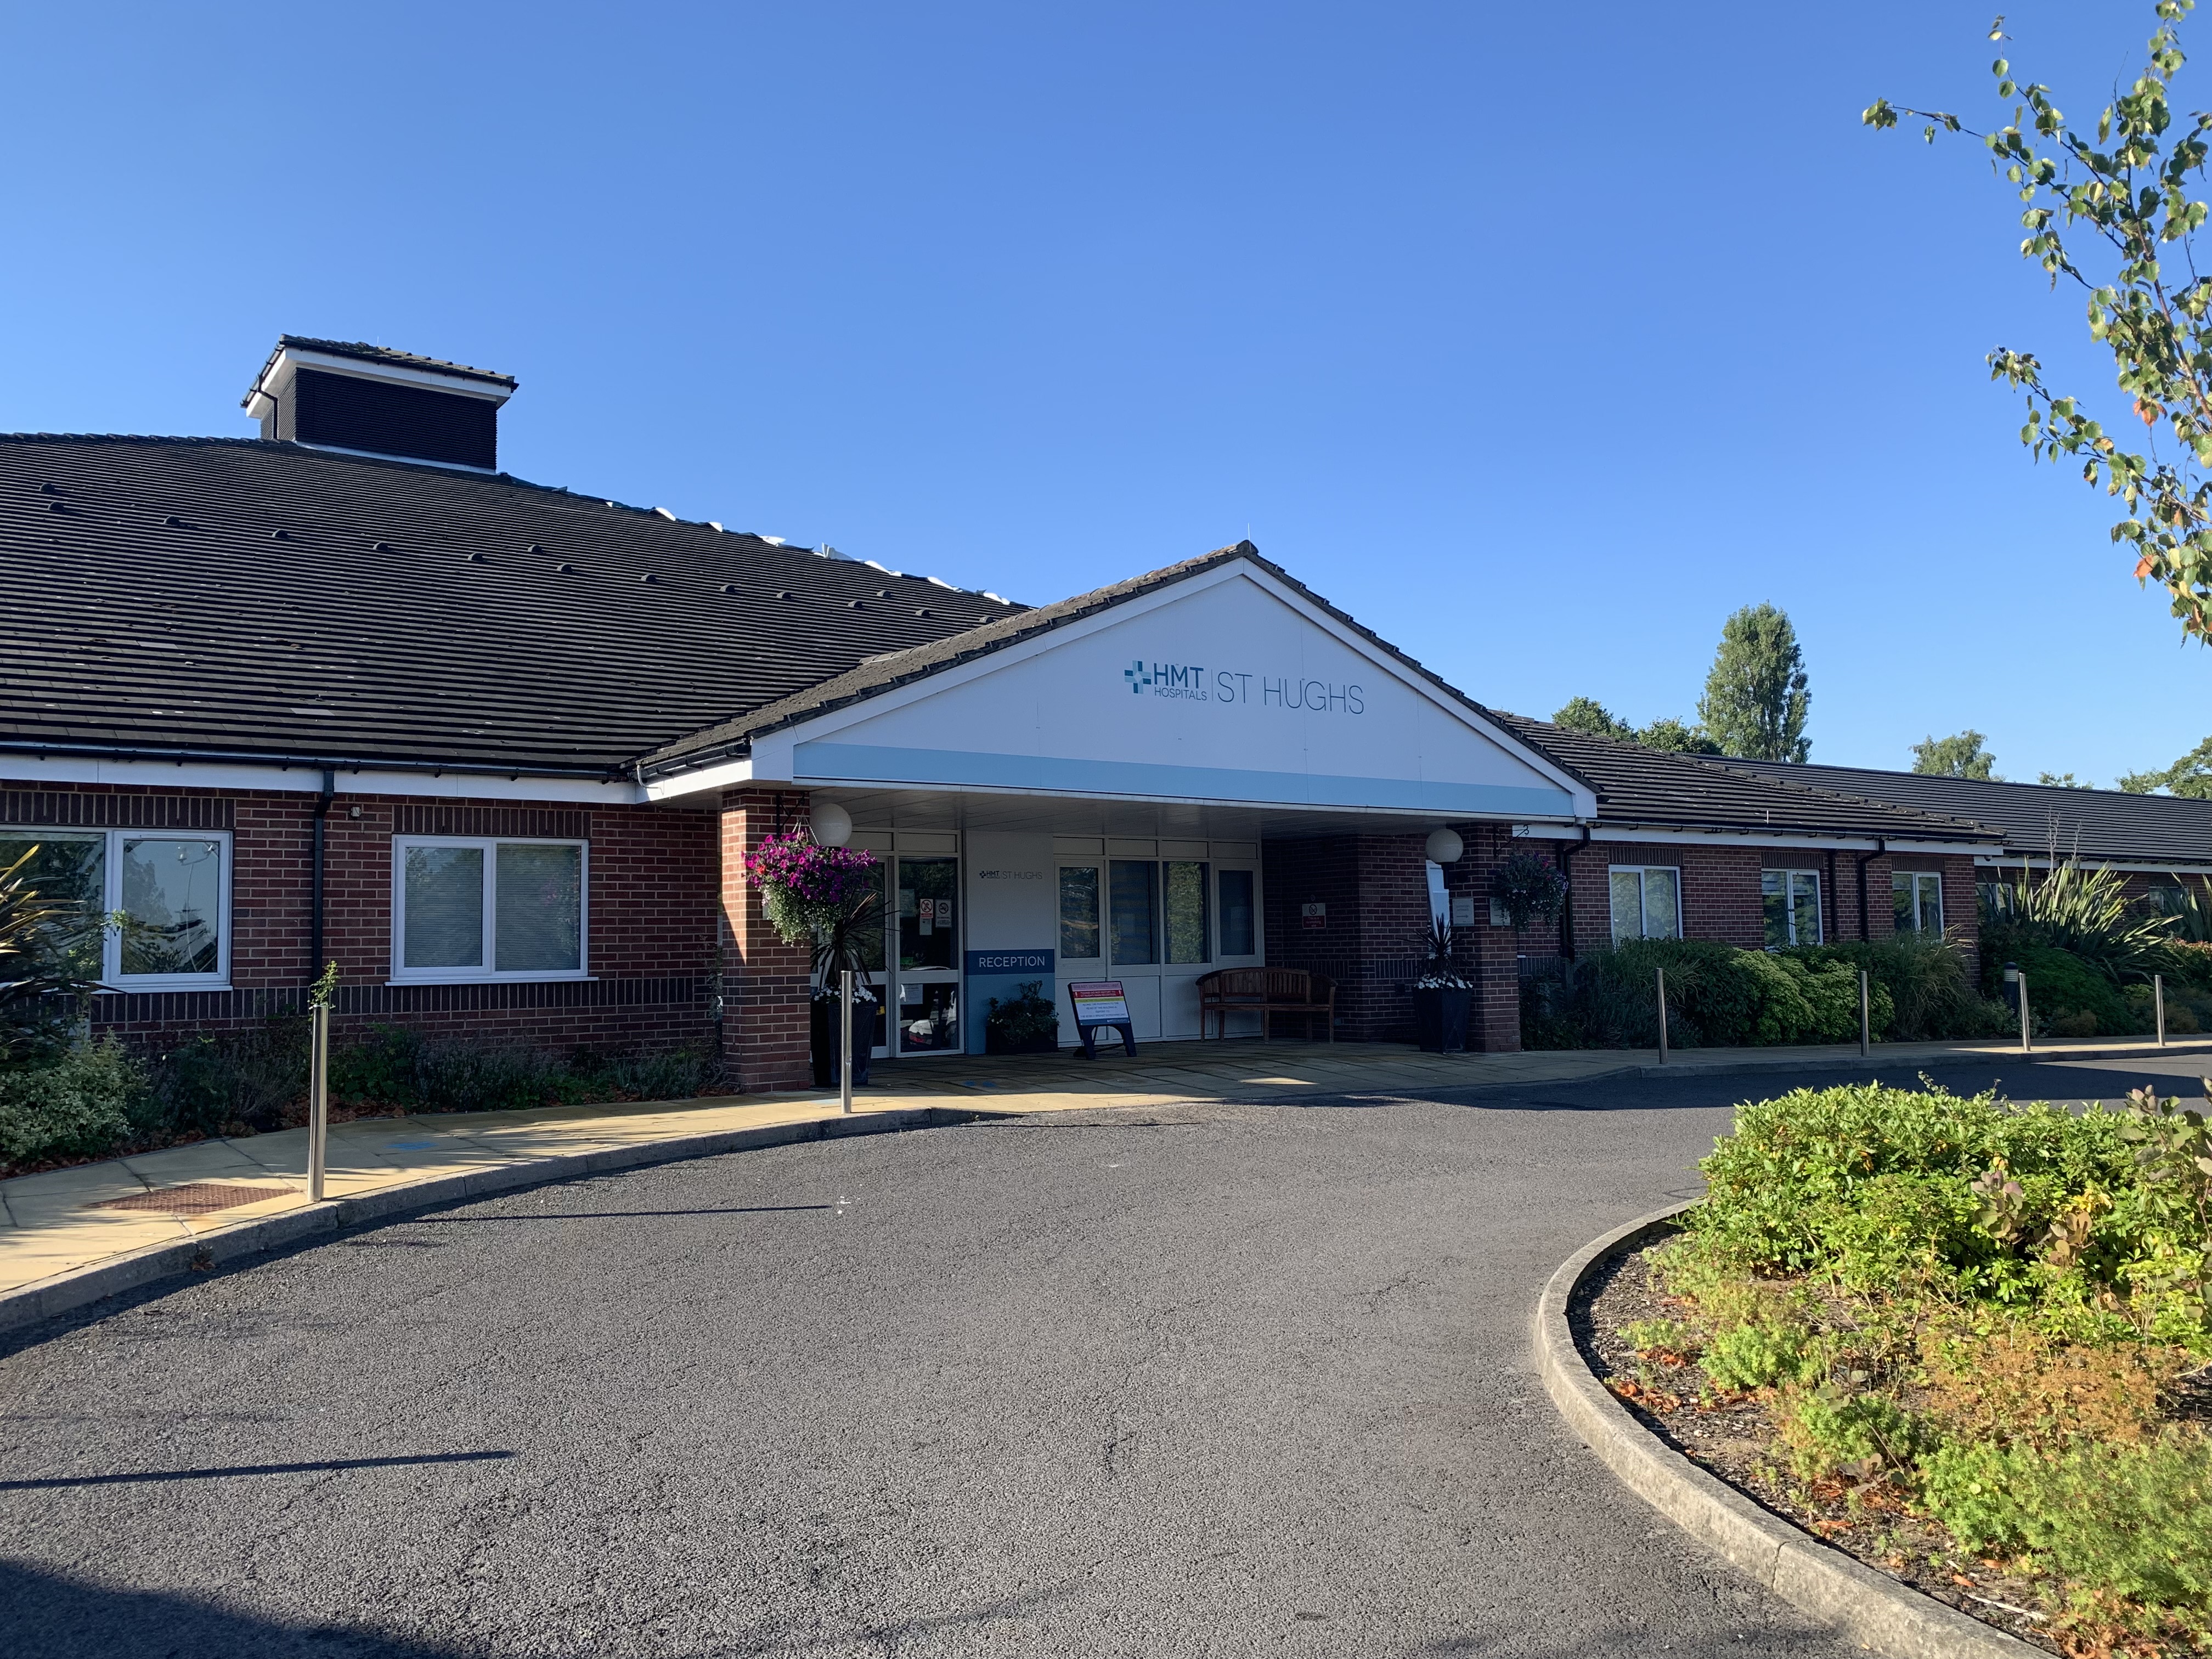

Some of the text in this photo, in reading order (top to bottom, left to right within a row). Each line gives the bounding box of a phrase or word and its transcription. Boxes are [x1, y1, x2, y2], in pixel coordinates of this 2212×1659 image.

[1154, 663, 1204, 689] HMT
[1154, 687, 1207, 701] HOSPITALS
[1217, 672, 1364, 714] ST HUGHS
[1014, 871, 1043, 879] HUGHS
[979, 956, 1045, 967] RECEPTION
